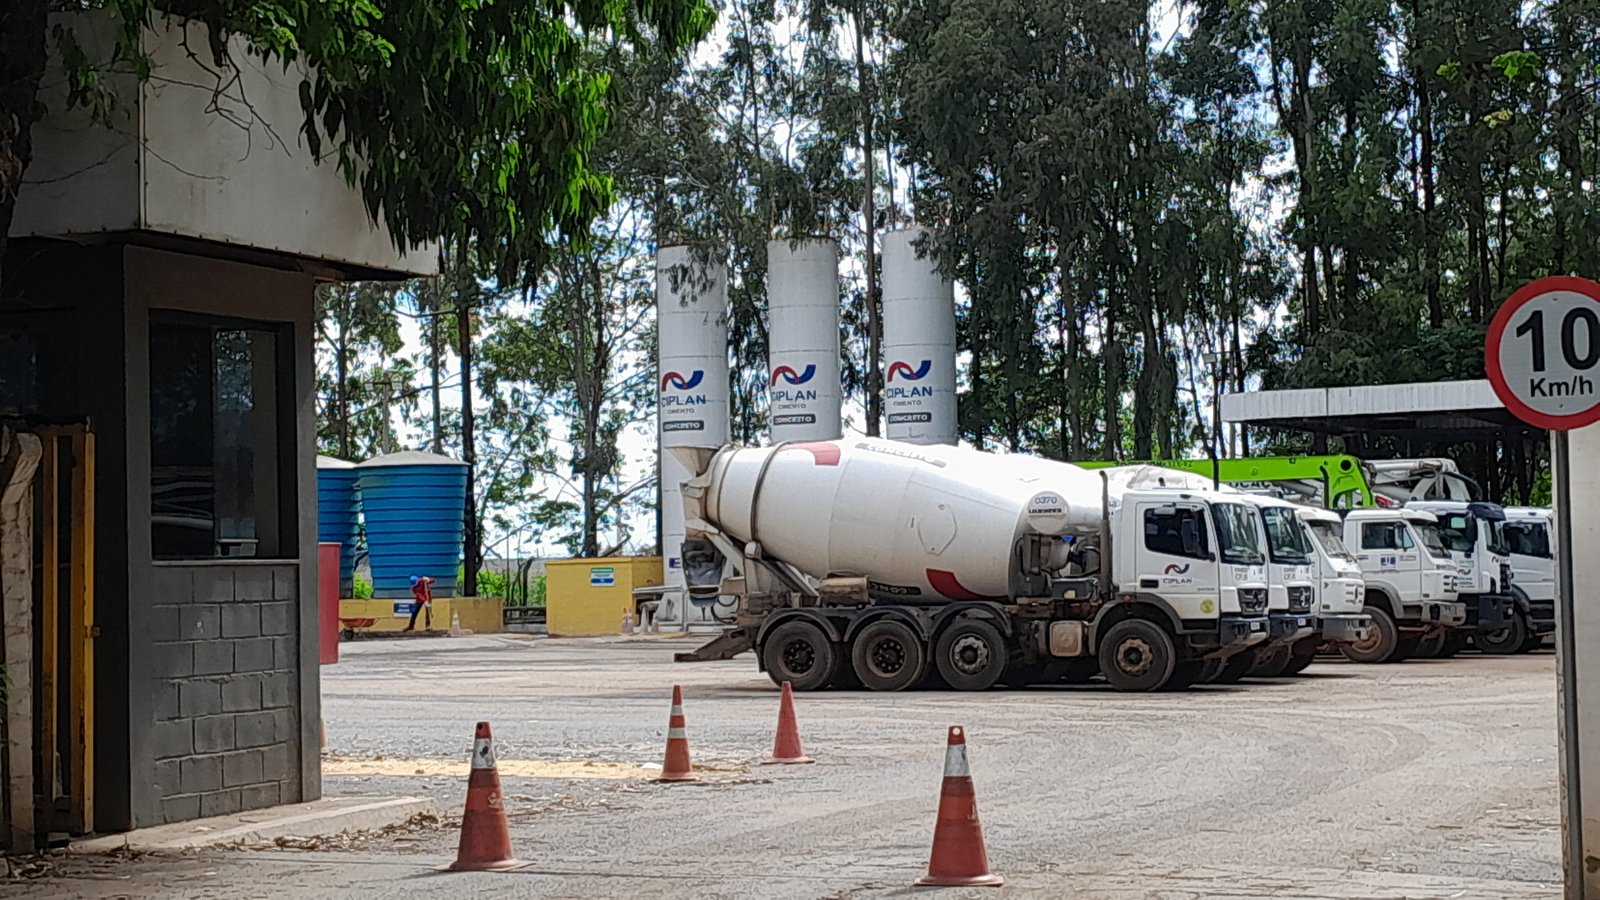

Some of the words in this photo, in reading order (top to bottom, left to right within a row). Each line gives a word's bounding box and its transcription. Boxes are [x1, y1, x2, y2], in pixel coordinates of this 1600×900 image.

[1516, 307, 1600, 372] 10
[886, 386, 933, 399] CIPLAN
[1530, 375, 1593, 397] Km/h
[661, 394, 706, 407] CIPLAN
[771, 390, 817, 401] CIPLAN
[1034, 496, 1058, 504] 0370
